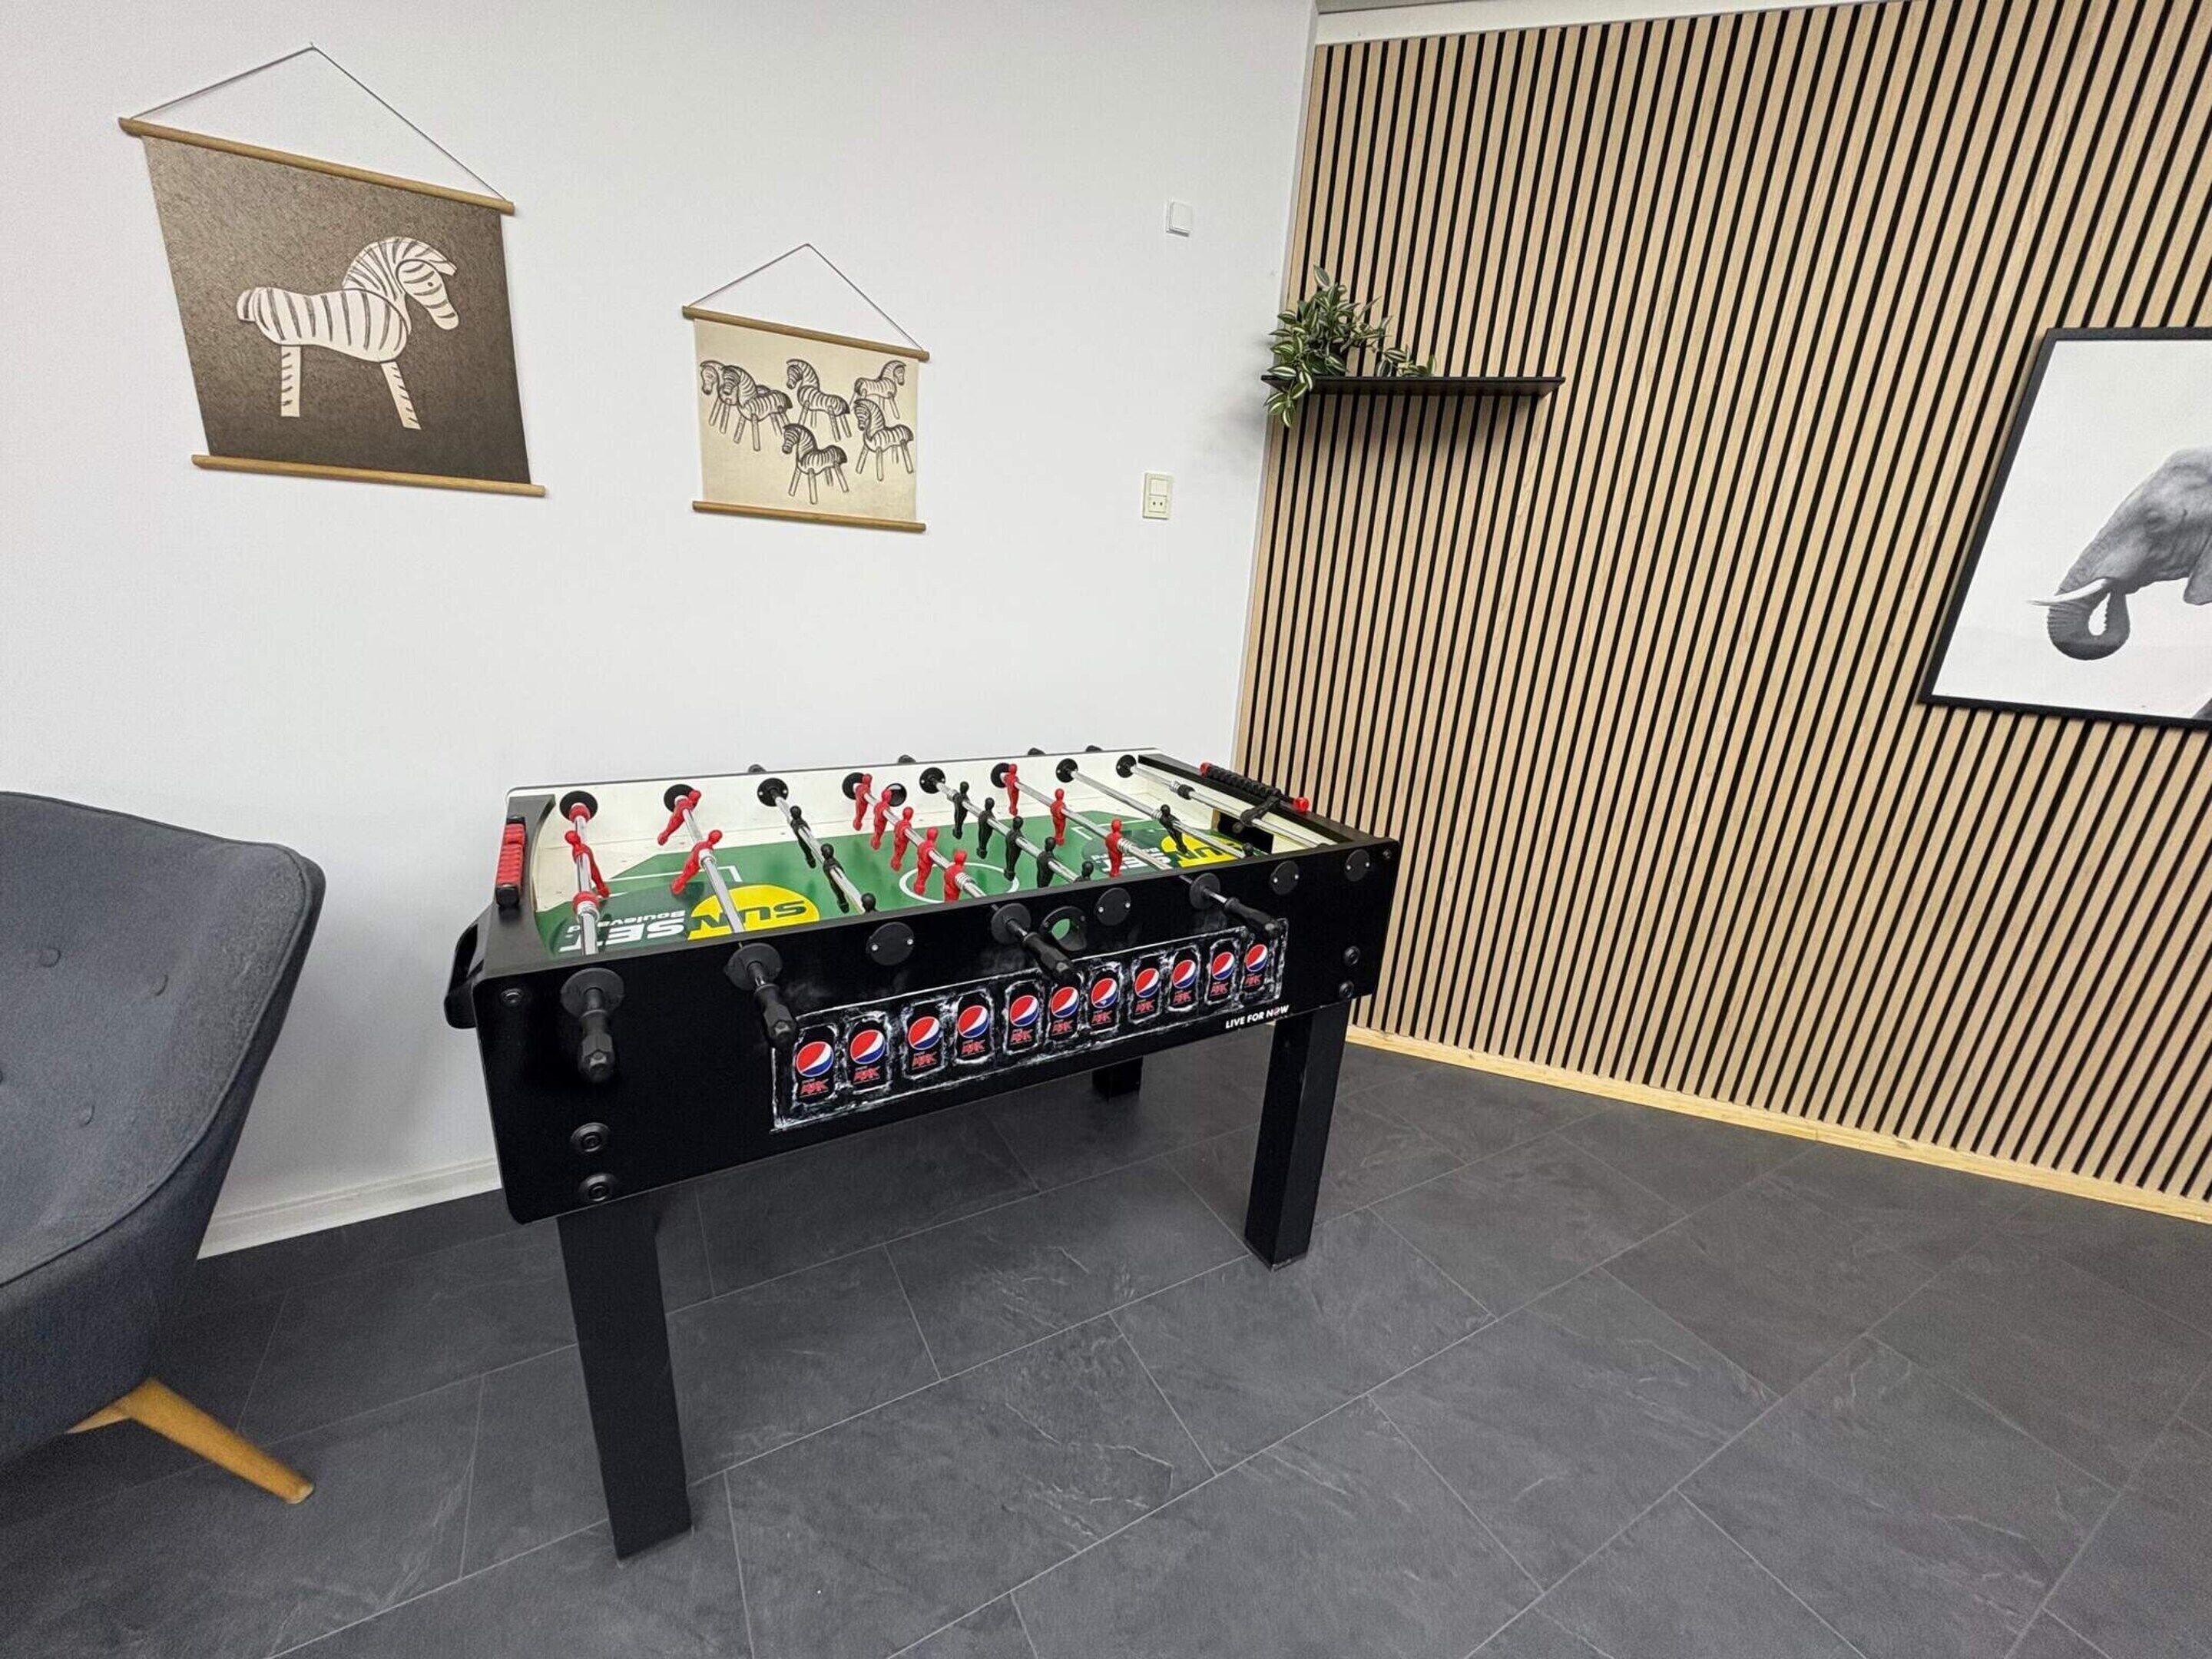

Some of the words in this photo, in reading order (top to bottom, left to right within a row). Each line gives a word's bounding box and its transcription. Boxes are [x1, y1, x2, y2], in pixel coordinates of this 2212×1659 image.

[567, 909, 686, 934] Boulevad
[1225, 1015, 1245, 1029] LIVE
[1247, 1011, 1265, 1023] FOR
[1266, 1004, 1290, 1018] NOW
